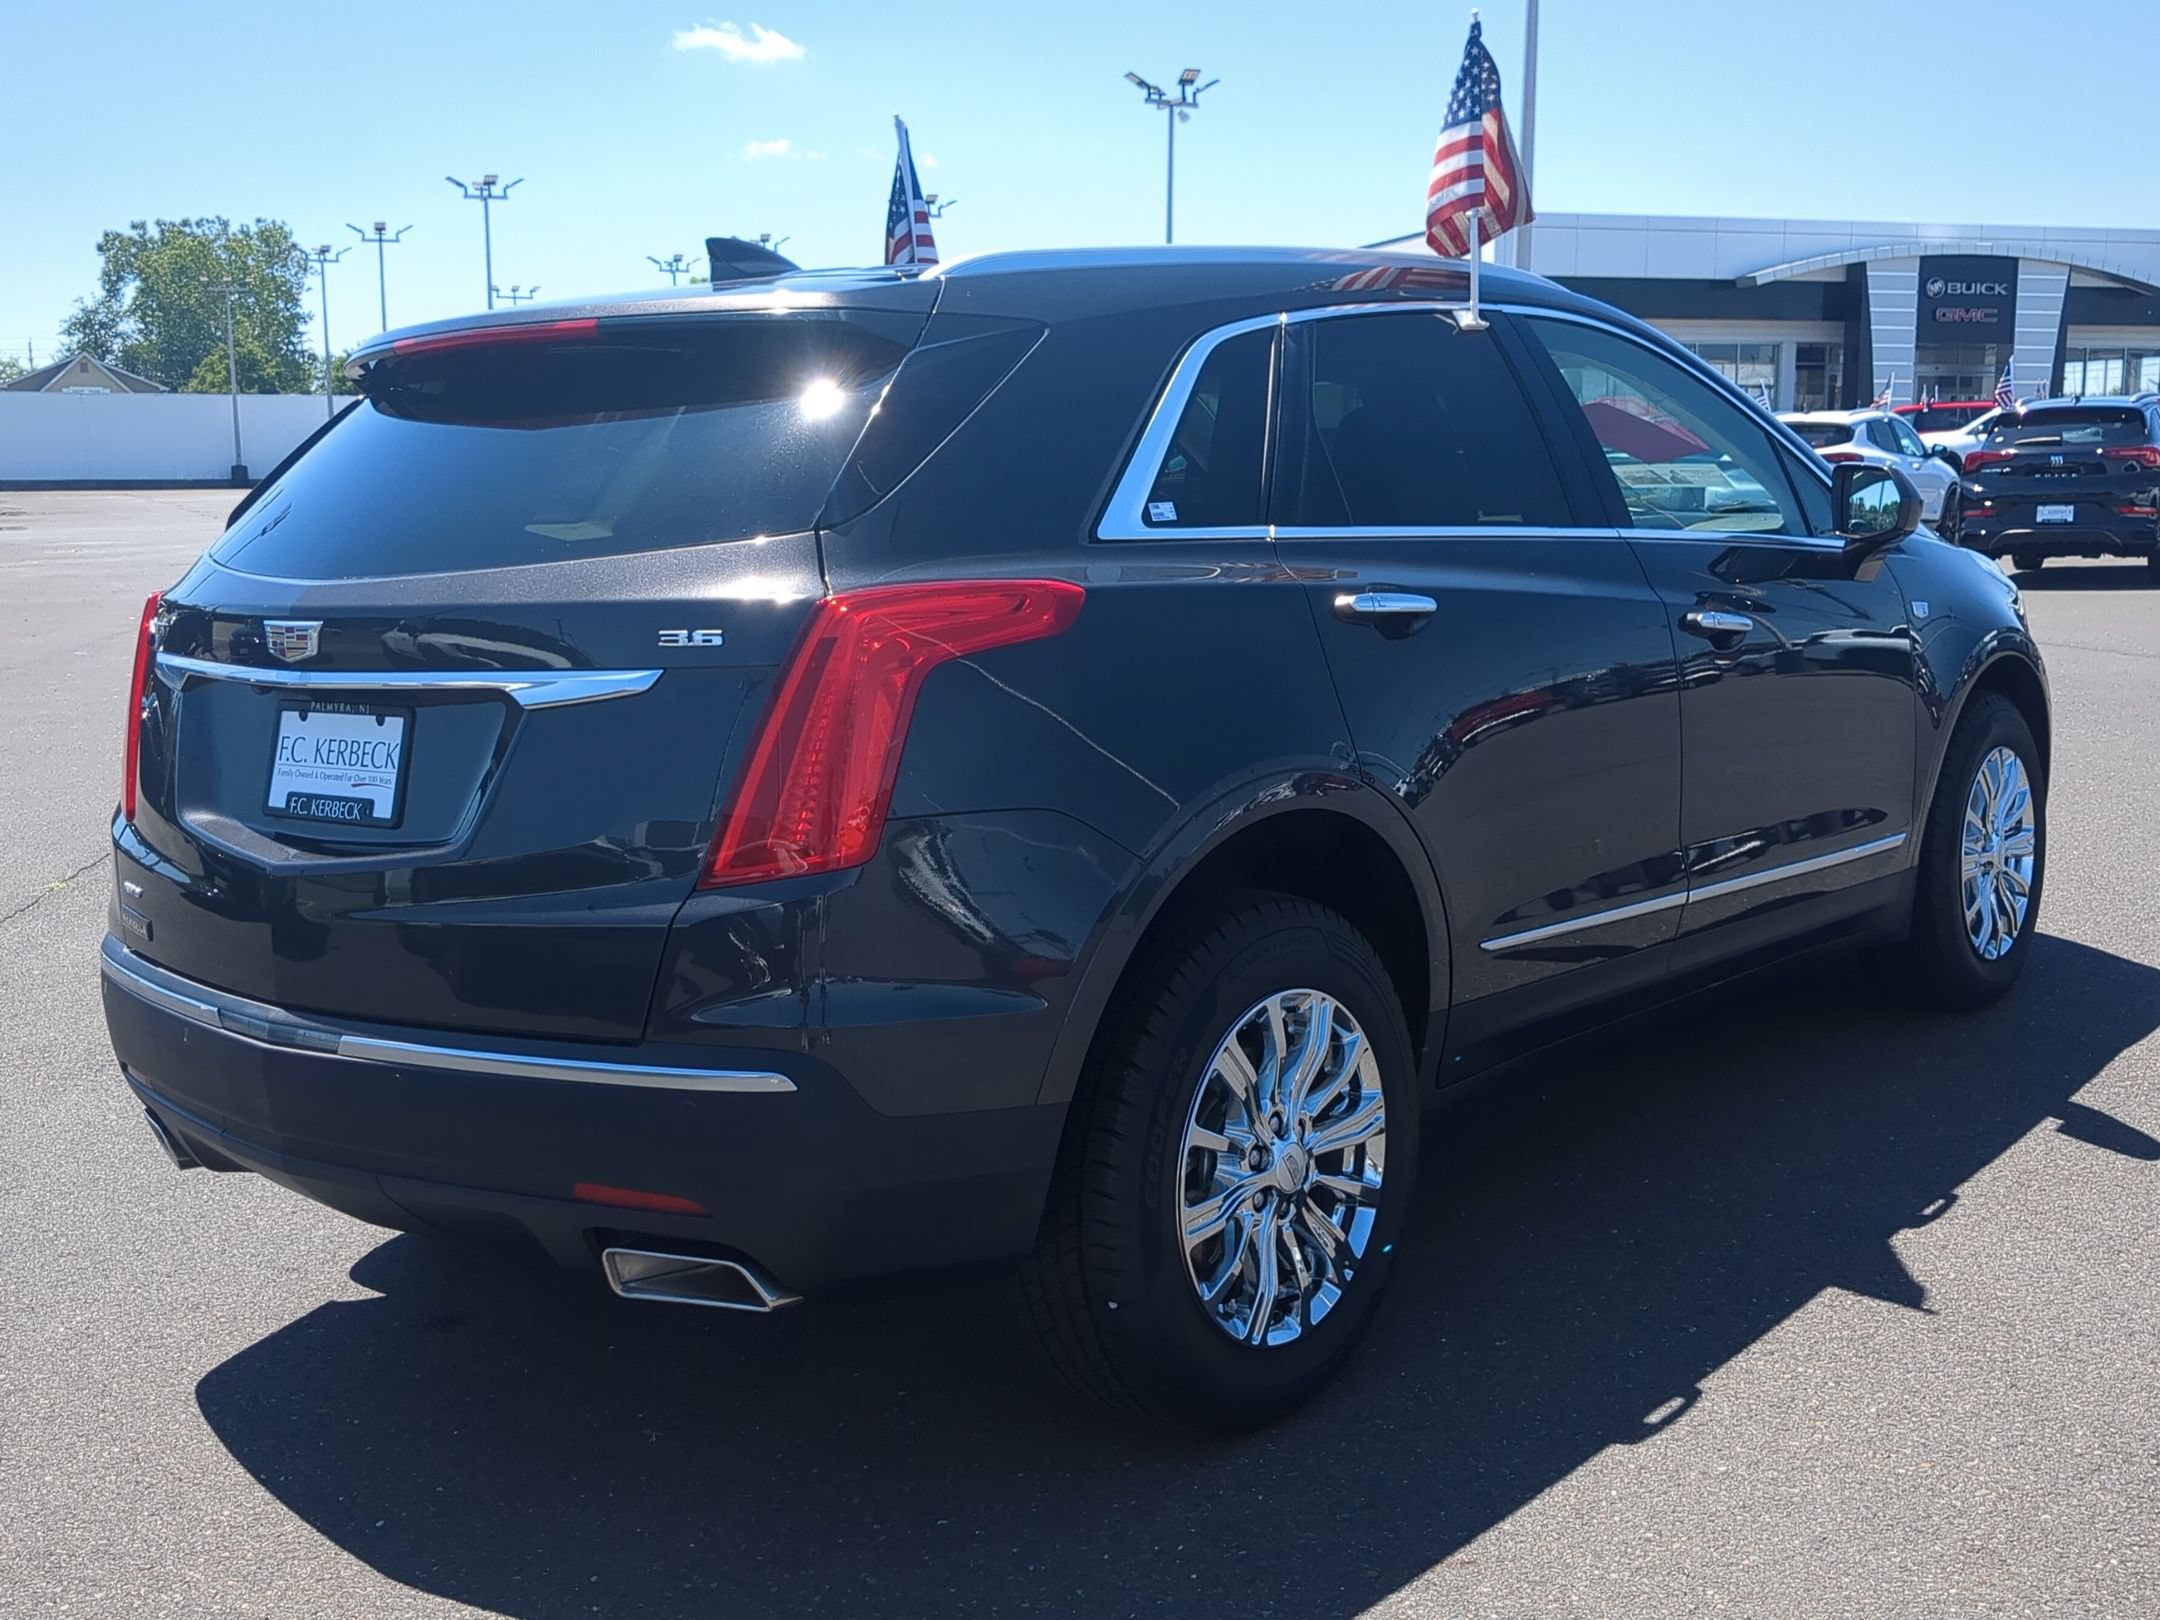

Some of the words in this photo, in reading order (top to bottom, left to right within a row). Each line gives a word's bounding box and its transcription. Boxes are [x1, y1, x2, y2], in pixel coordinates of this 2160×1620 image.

[1947, 282, 2008, 295] BUICK
[1936, 307, 1998, 323] GMC
[658, 629, 723, 646] 3.6
[279, 736, 307, 763] F.C.
[314, 737, 399, 770] KERBECK
[277, 768, 293, 779] Family
[295, 769, 314, 780] Owned
[320, 771, 344, 783] Operated
[354, 774, 367, 783] Over
[368, 775, 377, 783] 100
[379, 776, 392, 785] Years
[289, 797, 307, 815] F.C.
[310, 799, 363, 820] KERBECK
